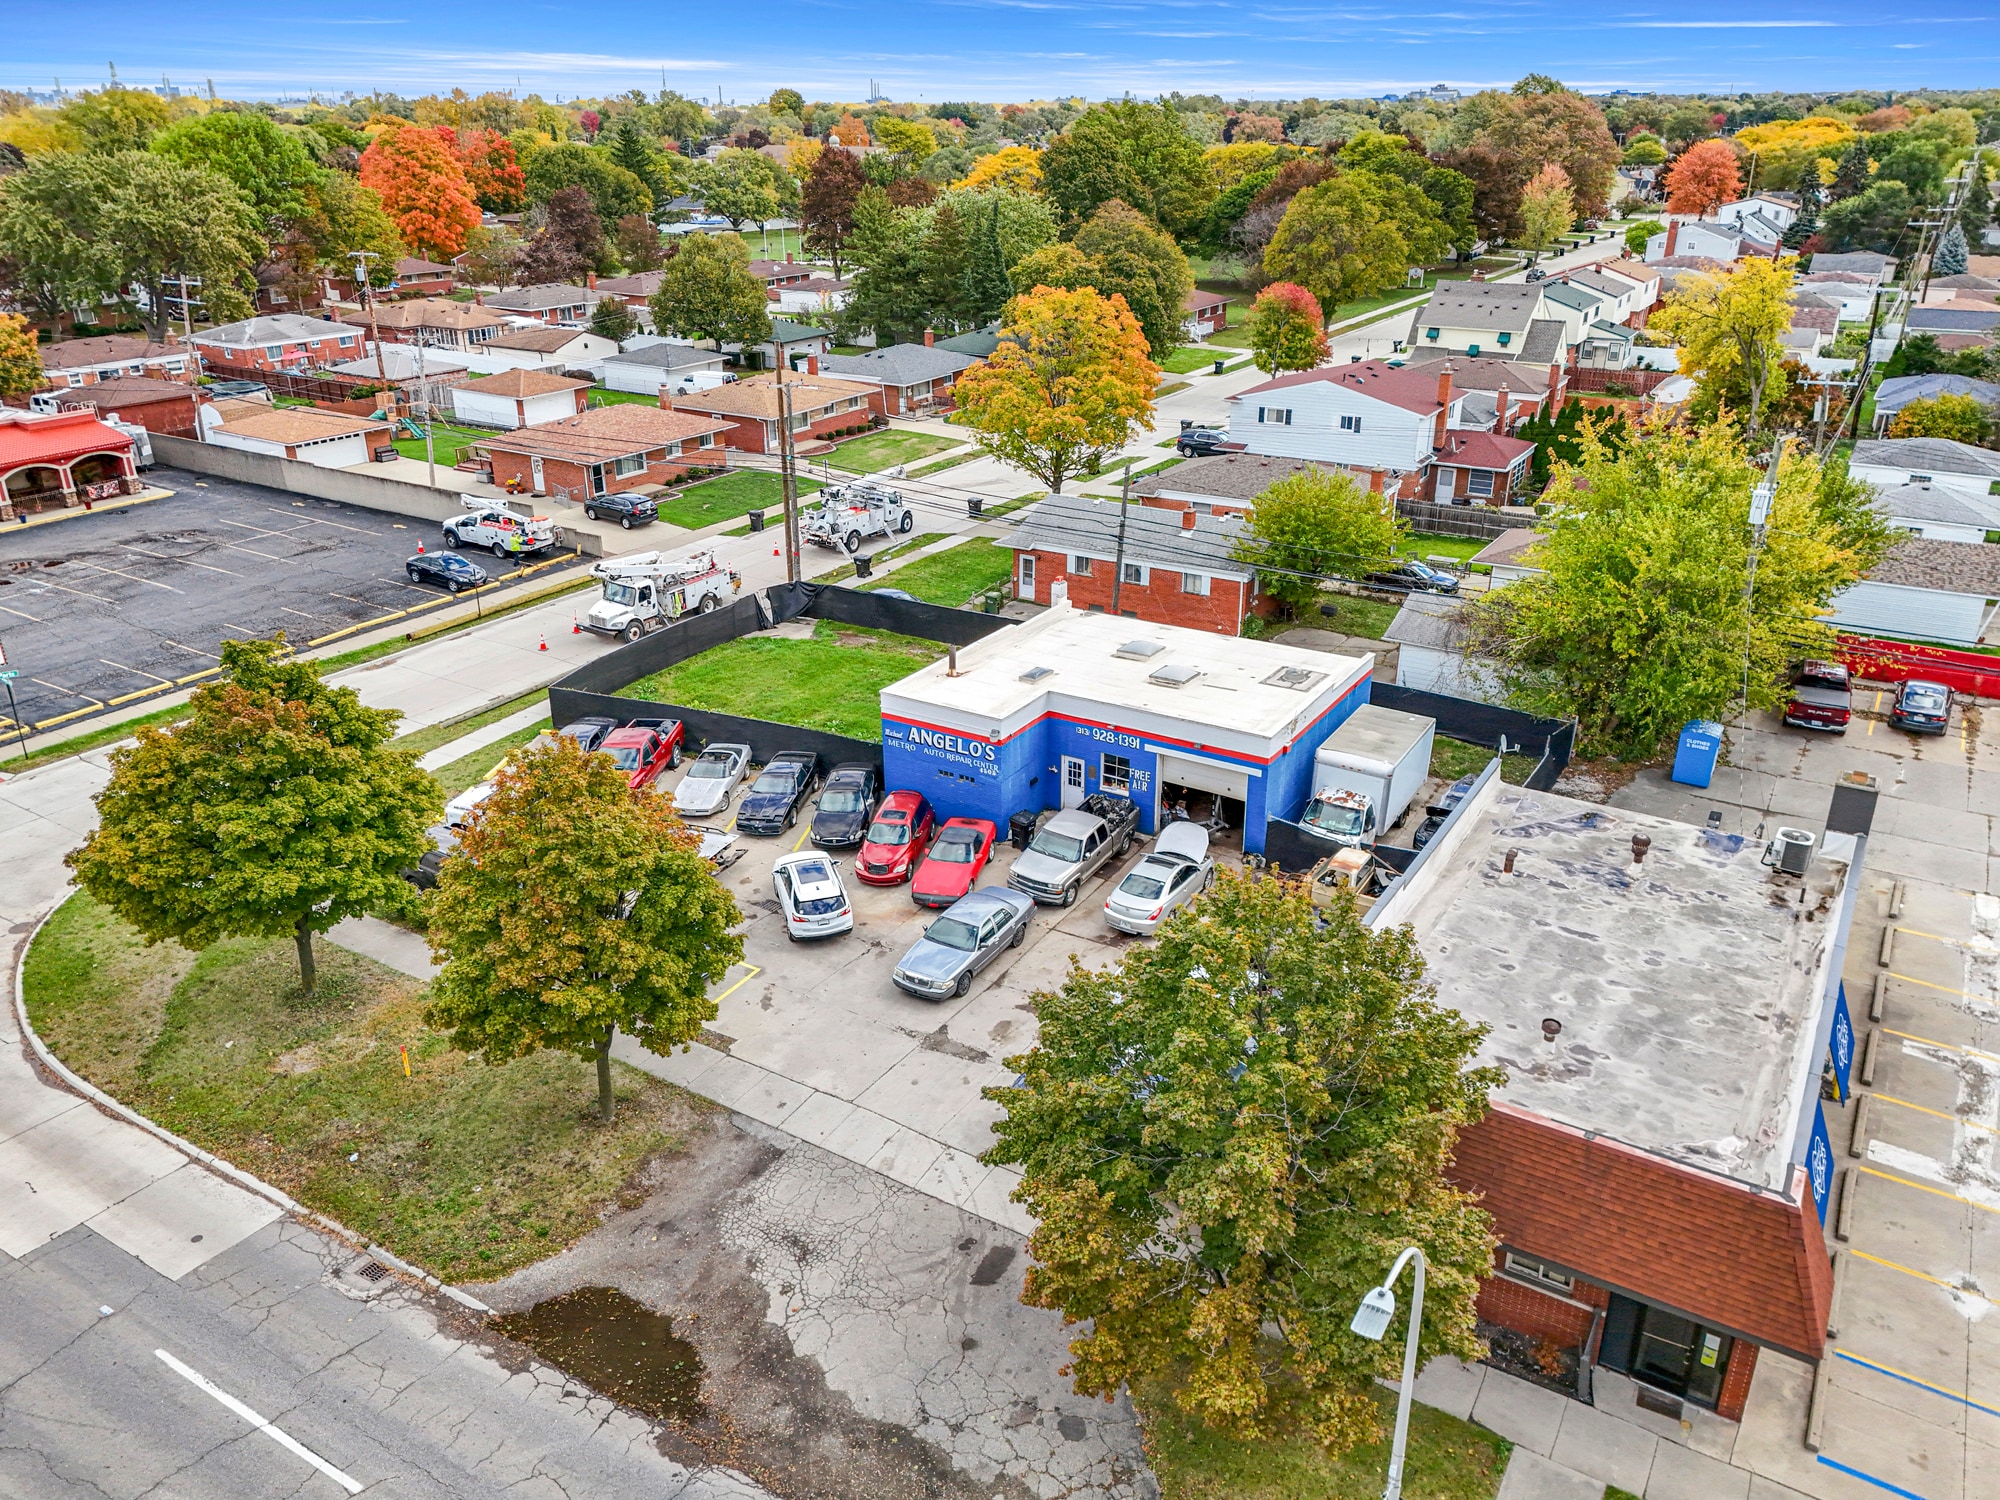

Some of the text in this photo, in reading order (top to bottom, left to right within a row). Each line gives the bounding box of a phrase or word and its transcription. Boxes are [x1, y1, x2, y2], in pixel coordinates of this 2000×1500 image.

[908, 727, 995, 761] ANGELO'S
[1093, 728, 1140, 749] 928-1391
[1687, 738, 1710, 747] CLOTHES
[888, 739, 999, 773] METRO AUTO REPAIR CENTER
[1129, 768, 1151, 782] FREE
[1132, 780, 1148, 792] AIR
